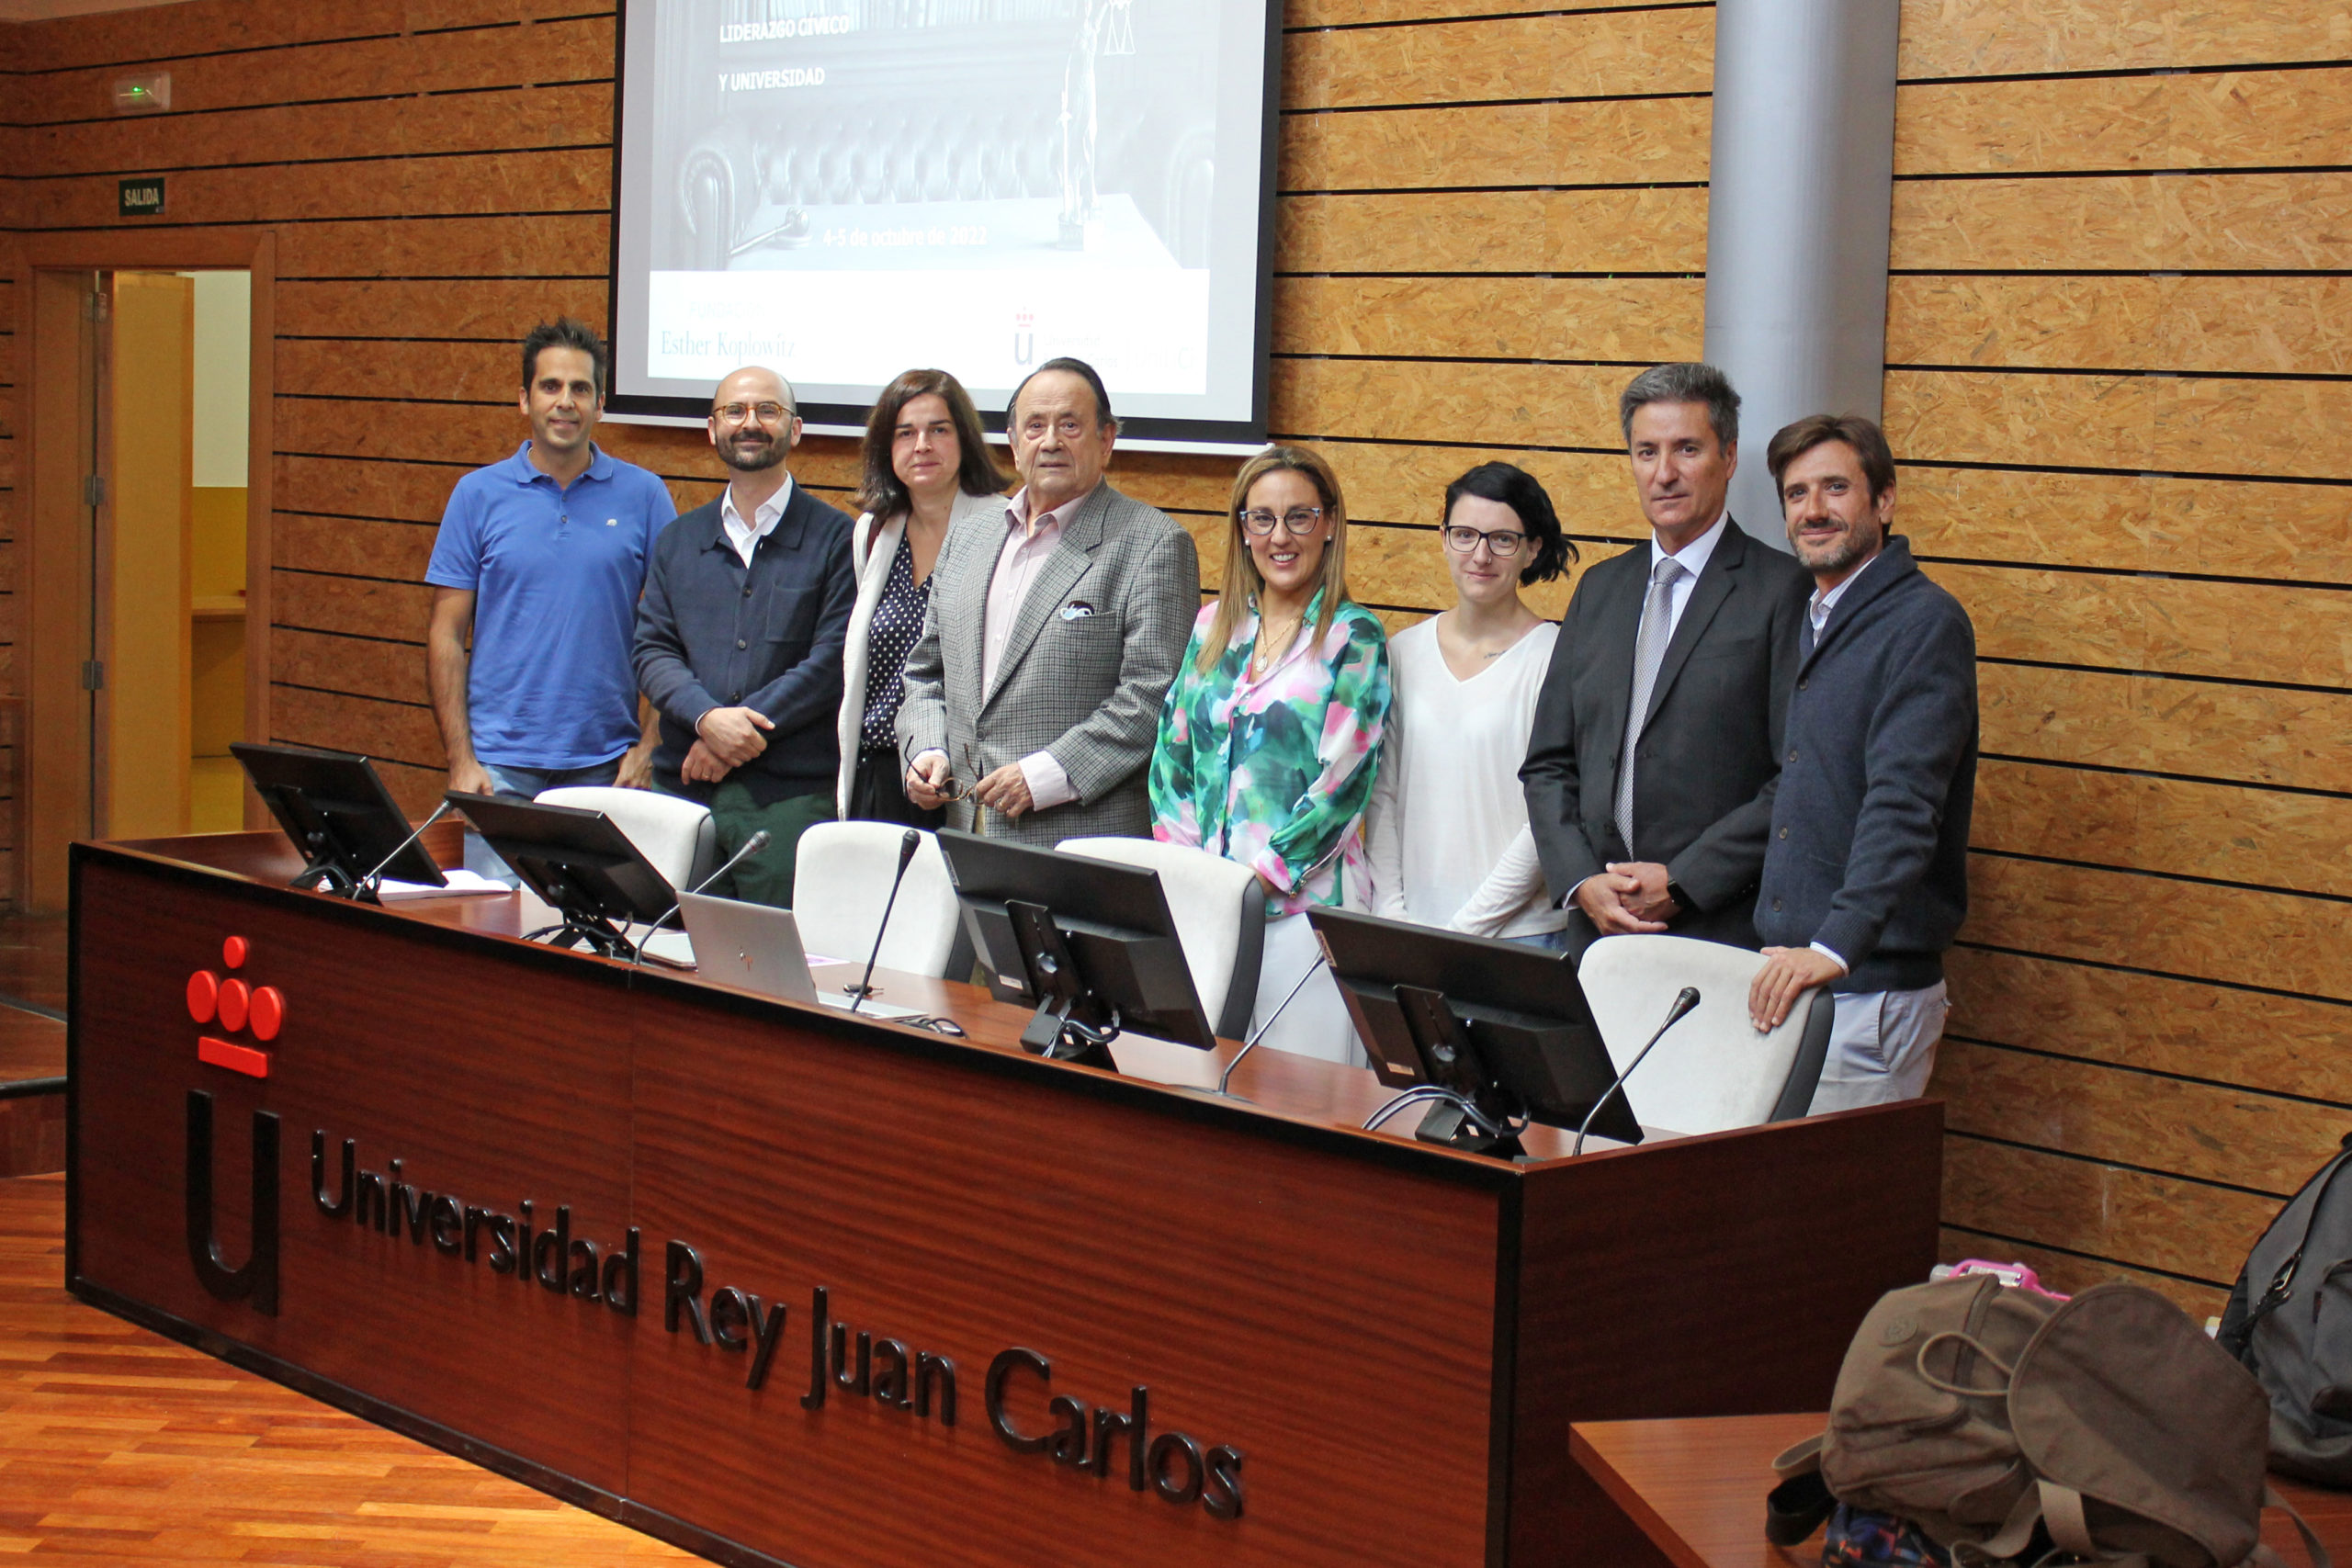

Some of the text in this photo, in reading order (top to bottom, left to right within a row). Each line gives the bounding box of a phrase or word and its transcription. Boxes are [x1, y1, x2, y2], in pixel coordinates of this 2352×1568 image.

[719, 11, 850, 43] LIDERAZGO CÍVICO
[718, 67, 825, 92] Y UNIVERSIDAD
[124, 186, 160, 207] SALIDA
[822, 225, 988, 247] 4-5 de octubre de 2022
[661, 330, 712, 356] Esther
[311, 1129, 1243, 1520] Universidad Rey Juan Carlos
